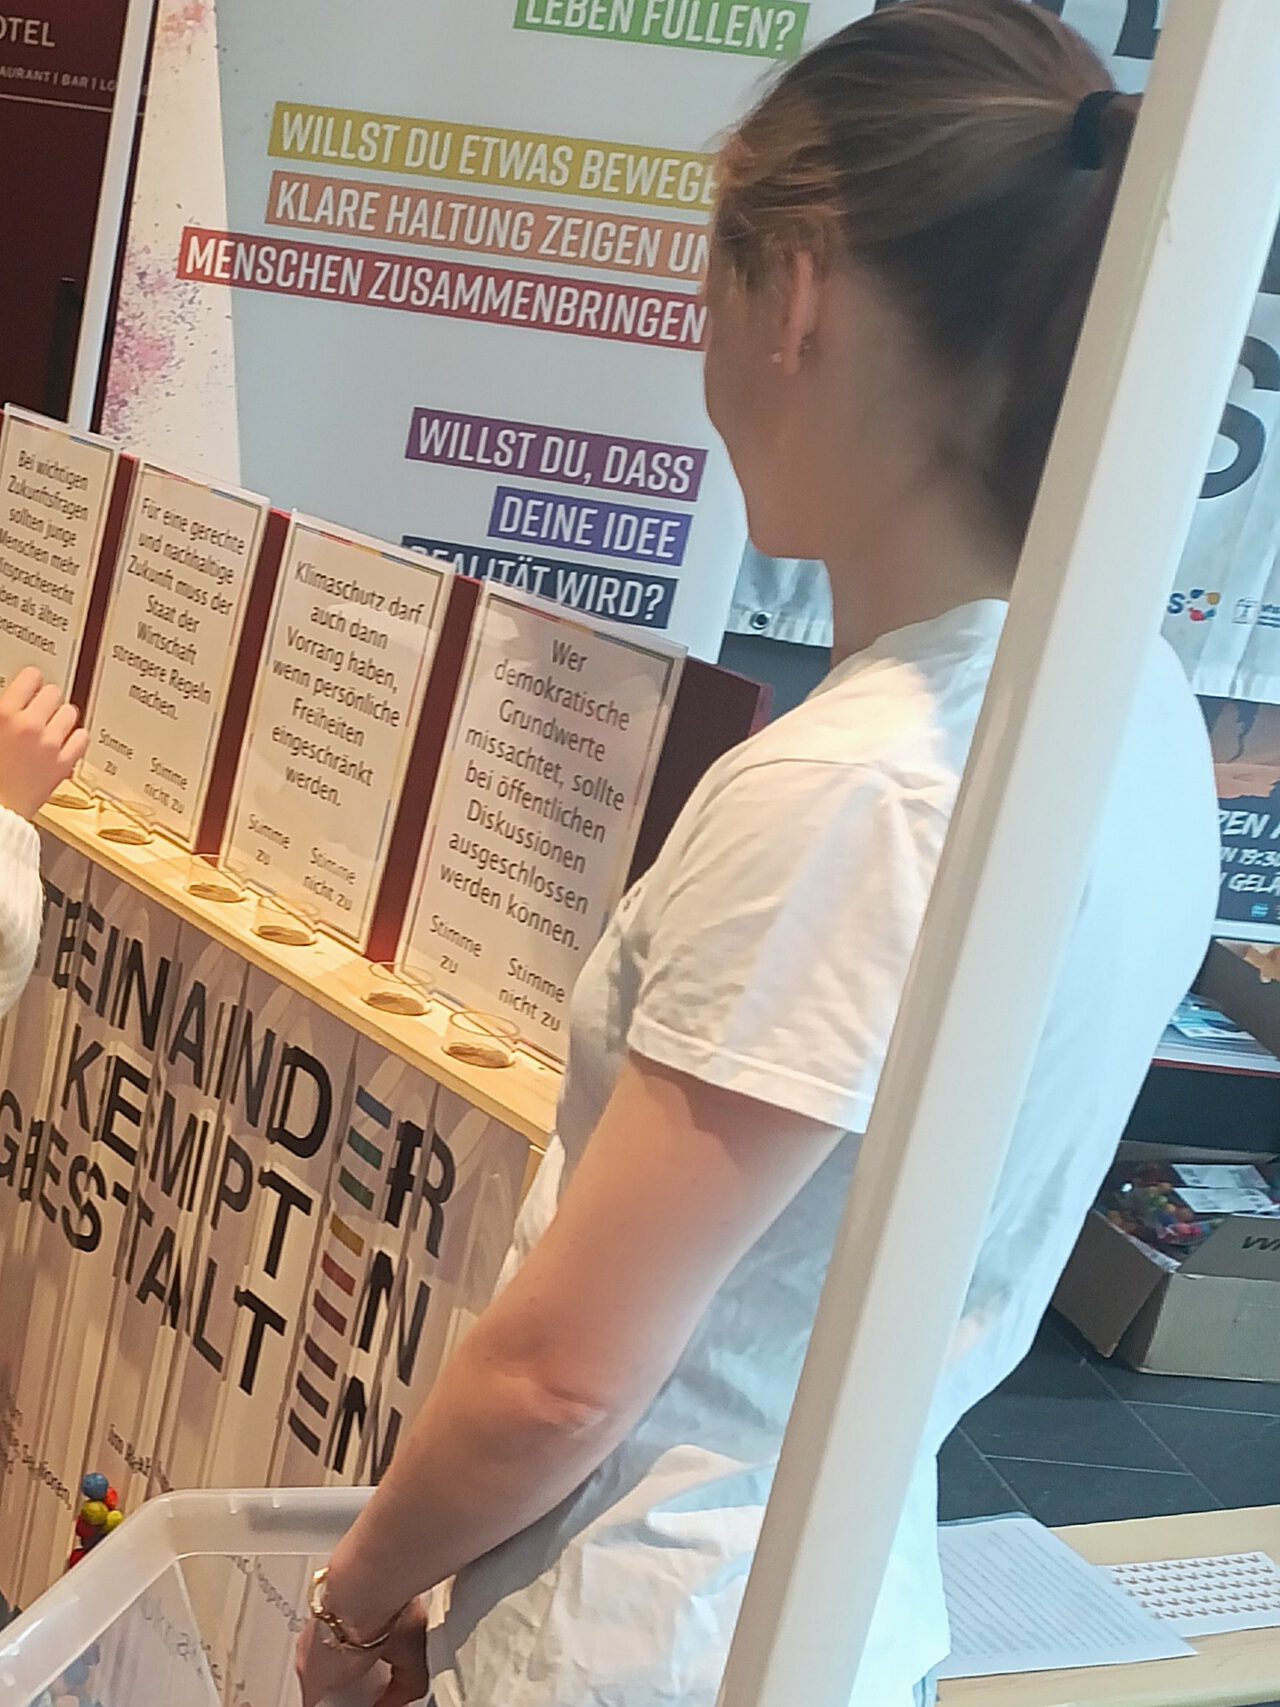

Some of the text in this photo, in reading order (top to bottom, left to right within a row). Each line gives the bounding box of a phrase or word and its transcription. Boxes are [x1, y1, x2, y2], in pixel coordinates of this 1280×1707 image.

[525, 0, 632, 33] LEBEN
[61, 72, 88, 88] BAR
[100, 78, 116, 92] LO
[280, 110, 715, 205] WILLST DU ETWAS BEWEGE
[275, 180, 381, 232] KLARE
[387, 195, 536, 252] HALTUNG
[540, 214, 662, 268] ZEIGEN
[184, 236, 708, 345] MENSCHEN ZUSAMMENBRINGEN
[18, 450, 88, 491] Bei wichtigen
[419, 417, 694, 495] WILLST DU, DASS
[7, 475, 88, 521] Zukunftsfragen
[9, 507, 77, 548] sollten junge
[142, 497, 245, 556] Für eine gerechte
[498, 497, 681, 559] DEINE IDEE
[51, 552, 80, 577] mehr
[138, 531, 234, 585] und nachhaltige
[127, 555, 234, 616] Zukunft muss der
[294, 561, 425, 626] Klimaschutz darf
[555, 569, 665, 620] WIRD?
[20, 596, 37, 617] als
[38, 603, 69, 632] ältere
[146, 594, 200, 635] Staat der
[310, 604, 389, 651] auch dann
[137, 620, 197, 666] Wirtschaft
[286, 625, 399, 695] Vorrang haben,
[551, 639, 588, 674] Wer
[112, 643, 211, 705] strengere Regeln
[272, 657, 401, 728] wenn persönliche
[493, 658, 630, 733] demokratische
[128, 683, 178, 720] machen.
[291, 697, 365, 748] Freiheiten
[99, 728, 133, 759] Stimme
[498, 699, 607, 763] Grundwerte
[104, 761, 117, 776] zu
[150, 757, 188, 790] Stimme
[271, 725, 374, 788] eingeschränkt
[464, 725, 626, 812] missachtet, sollte
[144, 782, 185, 815] nicht zu
[285, 764, 342, 807] werden.
[464, 759, 607, 844] bei öffentlichen
[247, 813, 291, 849] Stimme
[466, 799, 587, 875] Diskussionen
[1218, 810, 1271, 839] PEN
[255, 849, 271, 866] zu
[310, 846, 357, 885] Stimme
[448, 830, 589, 917] ausgeschlossen
[302, 873, 353, 912] nicht zu
[439, 862, 581, 952] werden können.
[1228, 872, 1280, 896] GELÄ
[429, 914, 483, 959] Stimme
[439, 953, 459, 976] zu
[508, 957, 565, 1004] Stimme
[498, 985, 562, 1033] nicht zu
